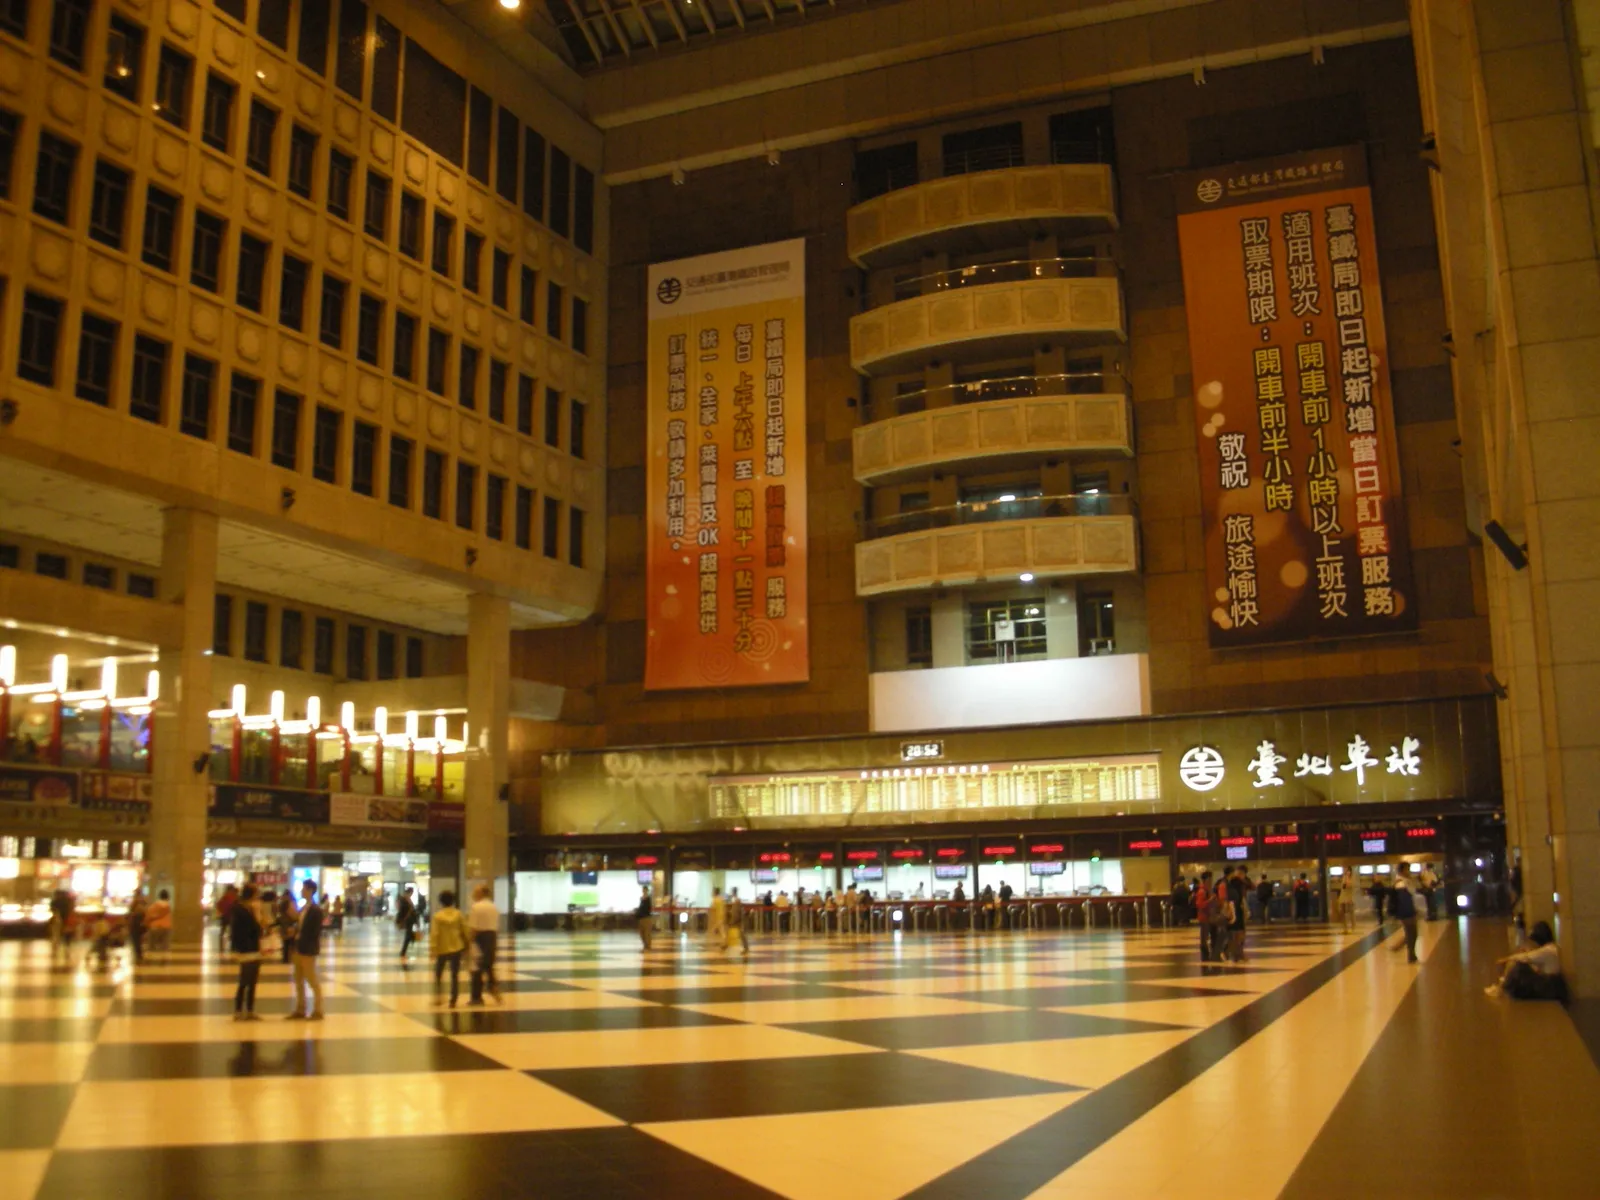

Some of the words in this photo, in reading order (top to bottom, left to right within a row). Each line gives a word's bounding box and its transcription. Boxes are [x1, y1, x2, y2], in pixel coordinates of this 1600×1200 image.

[1219, 434, 1249, 488] 敬祝
[699, 528, 719, 545] OK
[1225, 516, 1259, 628] 旅途愉快
[1247, 734, 1421, 788] 臺北車站
